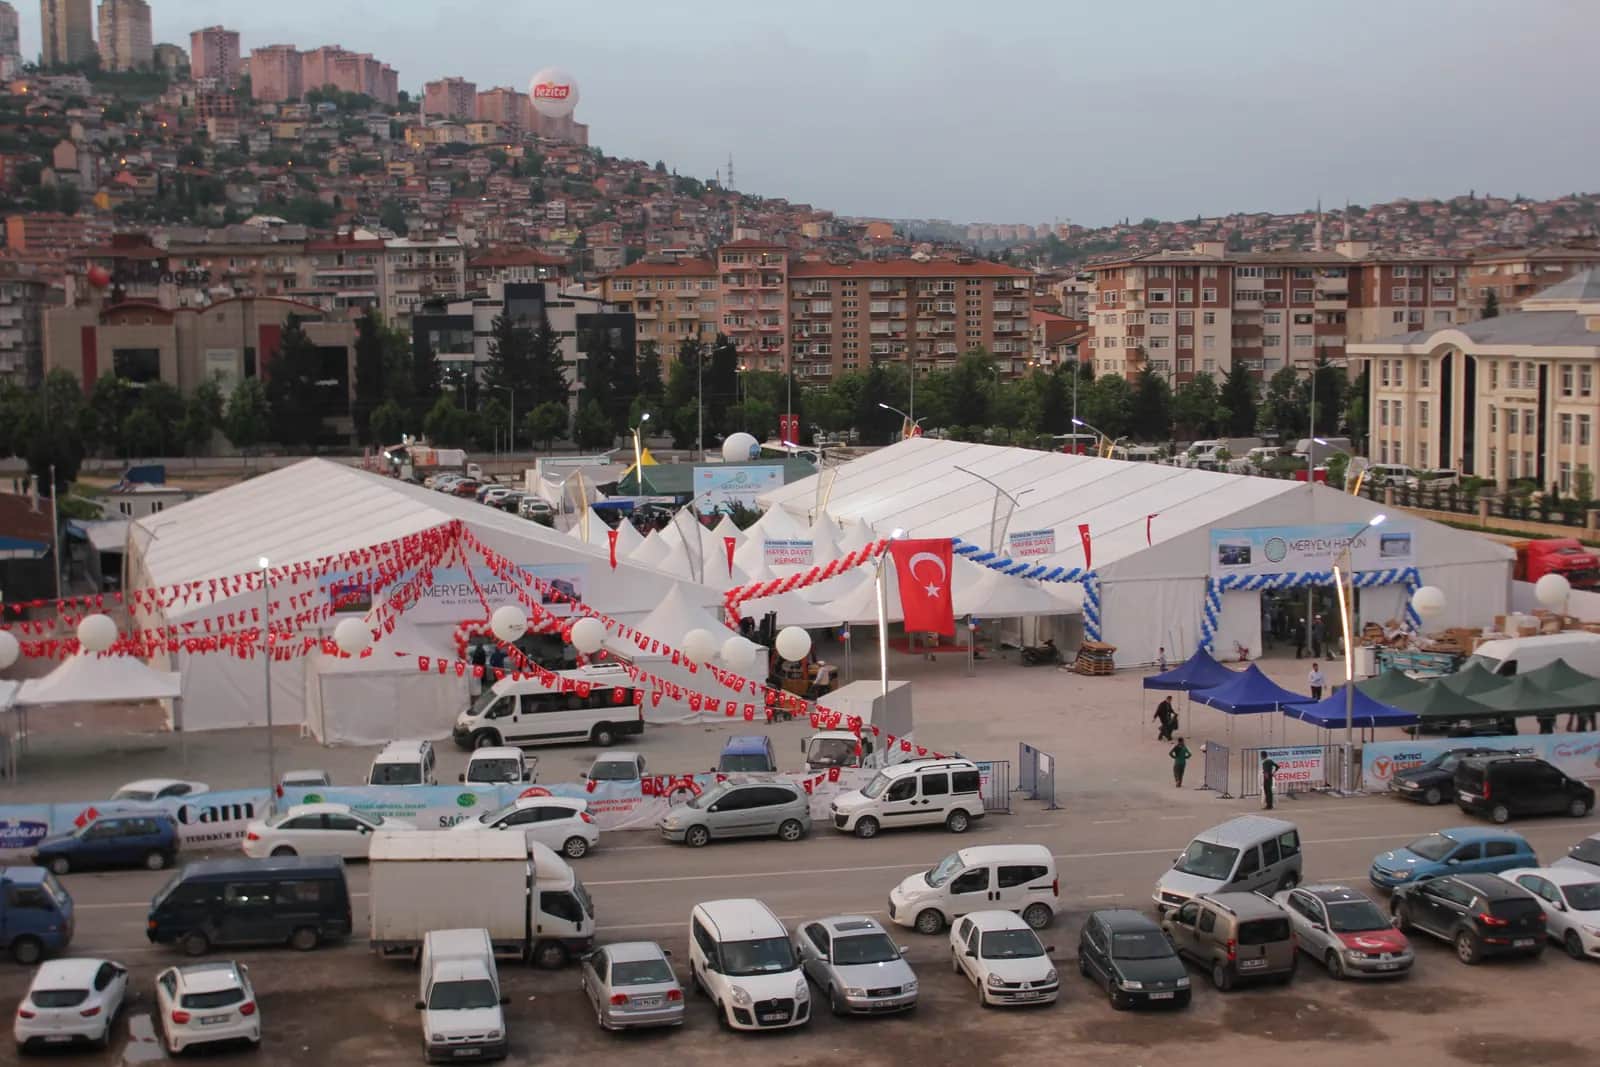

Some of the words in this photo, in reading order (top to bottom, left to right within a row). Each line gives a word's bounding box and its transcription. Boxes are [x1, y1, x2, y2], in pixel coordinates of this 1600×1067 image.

[1289, 538, 1331, 551] MERYEM
[423, 582, 478, 598] MERYEM
[1293, 760, 1320, 768] DAVET
[177, 802, 254, 824] Cam
